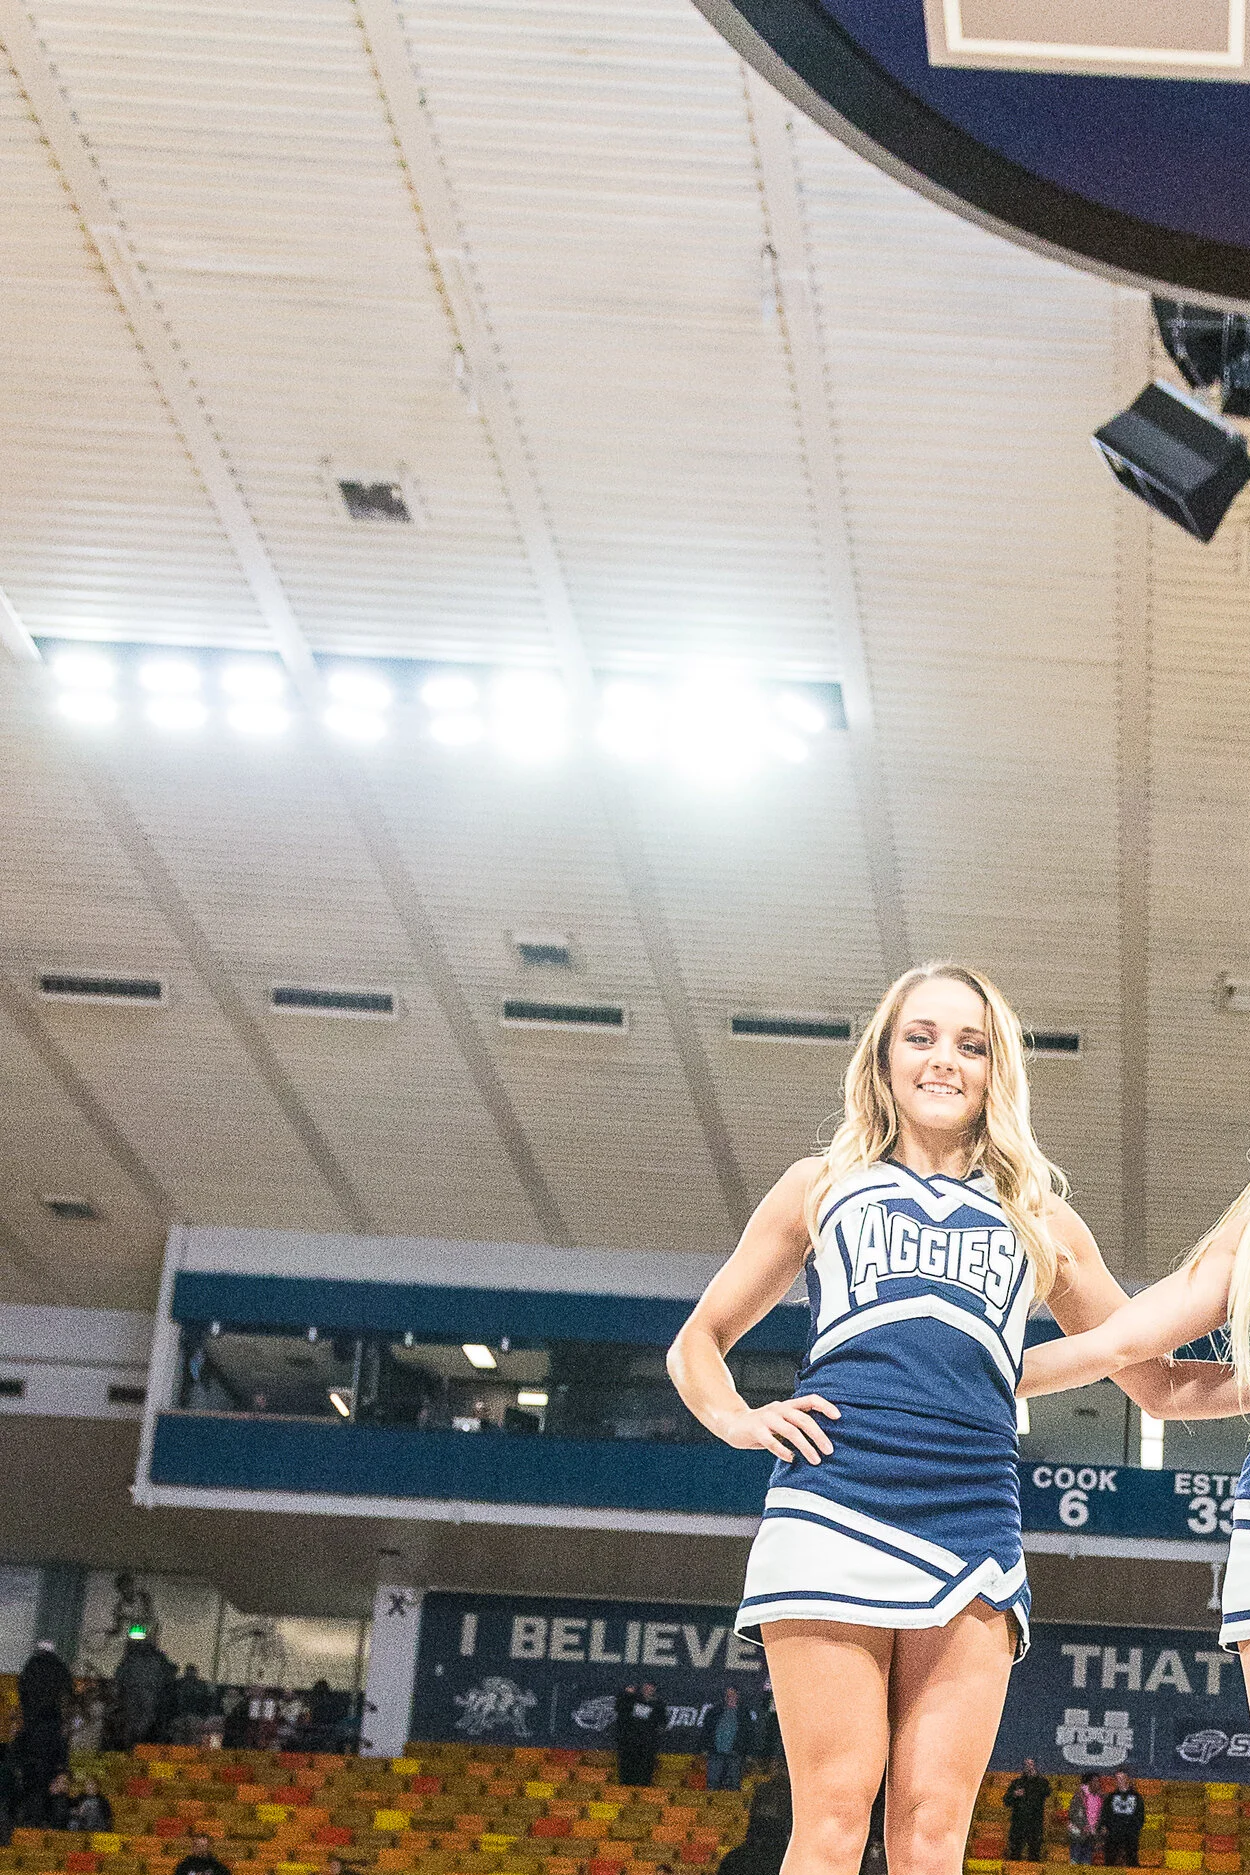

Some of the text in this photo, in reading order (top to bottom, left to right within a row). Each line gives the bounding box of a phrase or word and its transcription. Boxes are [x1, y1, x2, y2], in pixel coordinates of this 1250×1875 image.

[853, 1203, 1017, 1309] AGGIES
[1032, 1465, 1118, 1492] COOK
[1058, 1489, 1090, 1528] 6
[460, 1613, 762, 1671] I BELIEVE
[1061, 1644, 1235, 1696] THAT
